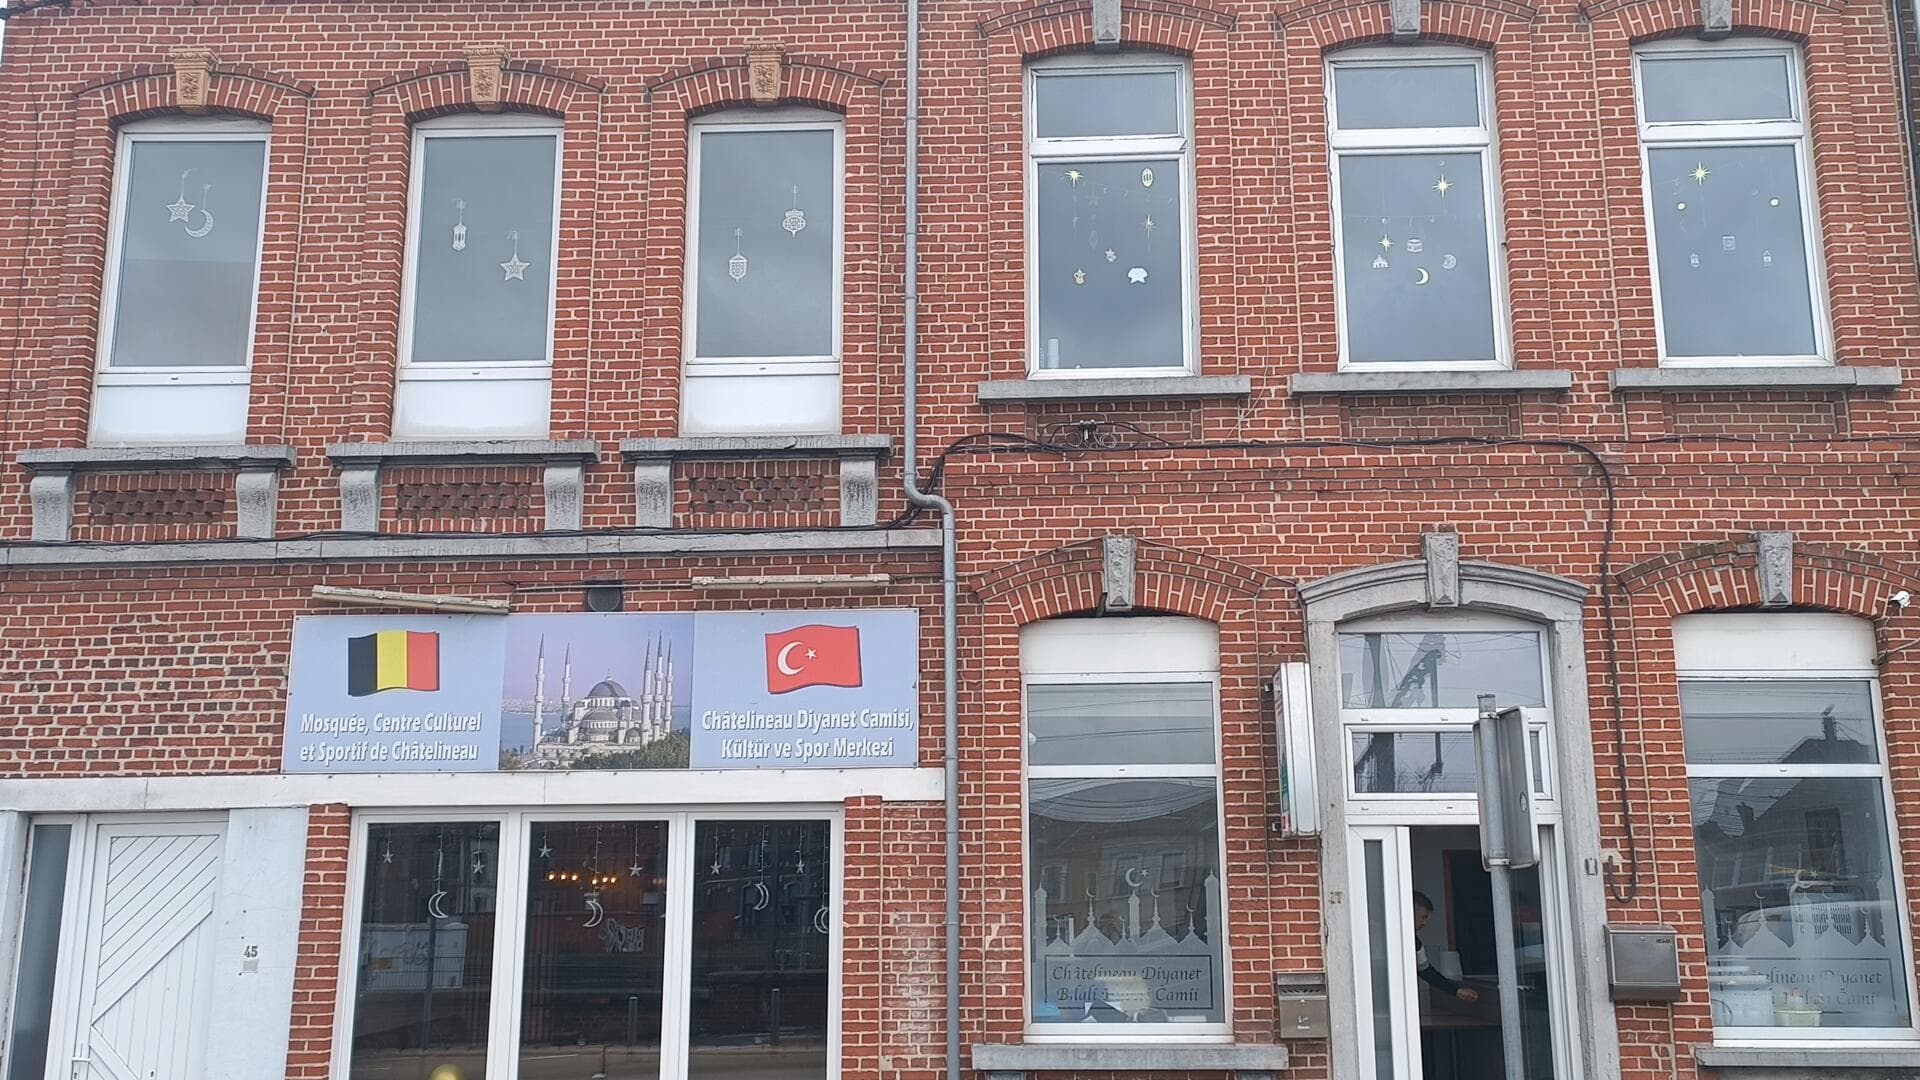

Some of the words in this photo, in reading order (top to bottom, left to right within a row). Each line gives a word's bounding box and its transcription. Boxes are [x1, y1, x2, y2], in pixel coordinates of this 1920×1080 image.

[300, 713, 370, 738] Mosquée,
[373, 713, 421, 733] Centre
[424, 712, 482, 732] Culturel
[702, 711, 793, 731] Châtelineau
[797, 709, 857, 735] Diyanet
[860, 708, 914, 731] Camisi,
[300, 744, 315, 761] et
[318, 741, 368, 767] Sportif
[370, 742, 389, 761] de
[391, 740, 480, 761] Châtelineau
[721, 738, 771, 759] Kültür
[774, 742, 792, 757] ve
[795, 737, 830, 763] Spor
[833, 737, 894, 757] Merkezi
[243, 945, 259, 958] 45
[1141, 966, 1202, 987] Diyanet
[1155, 988, 1200, 1001] Camii
